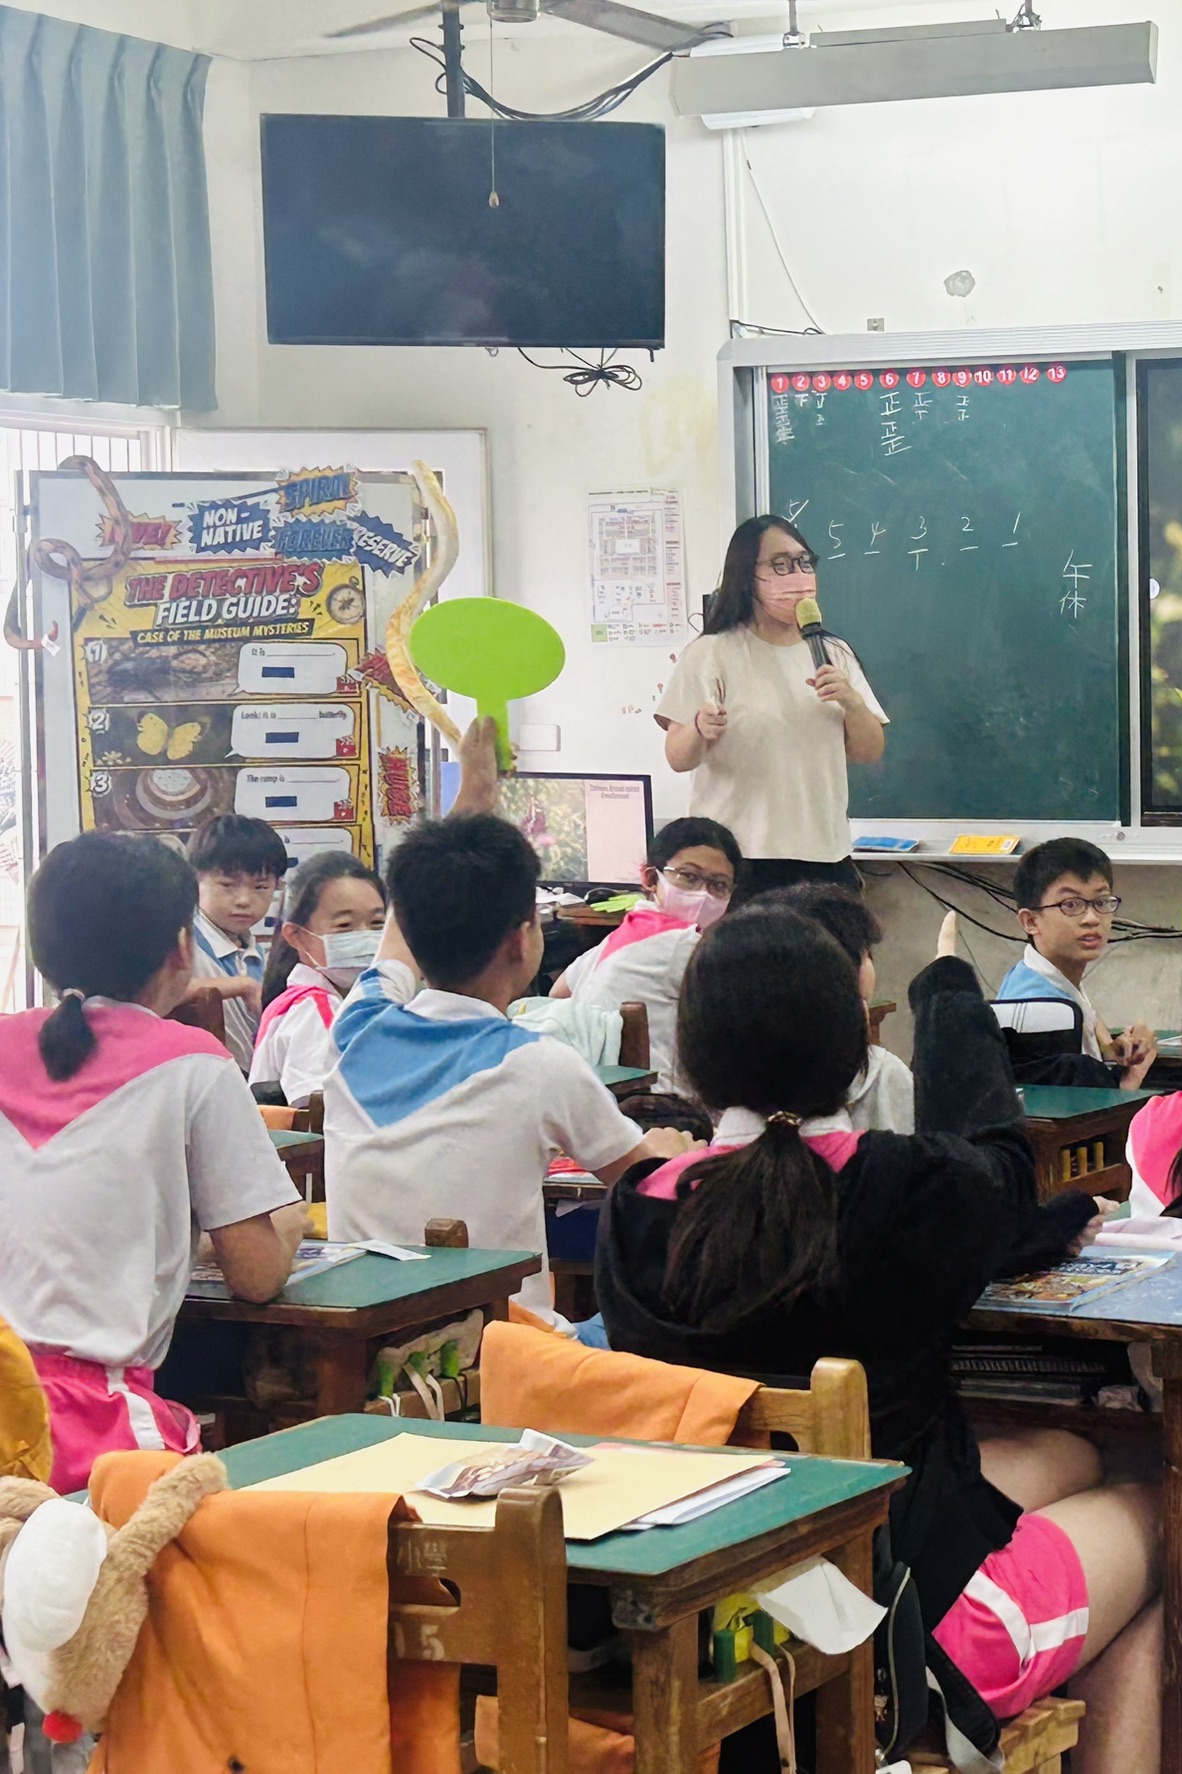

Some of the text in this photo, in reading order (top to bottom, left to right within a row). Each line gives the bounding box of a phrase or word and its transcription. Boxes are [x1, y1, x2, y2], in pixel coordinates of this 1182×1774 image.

[796, 375, 806, 385] 2
[818, 375, 827, 388] 3
[838, 373, 848, 386] 4
[859, 374, 869, 386] 5
[885, 373, 895, 385] 6
[911, 372, 920, 384] 7
[937, 372, 946, 384] 8
[957, 372, 967, 384] 9
[975, 370, 992, 384] 10
[1001, 369, 1014, 381] 11
[1024, 366, 1039, 380] 12
[1050, 366, 1065, 379] 13
[201, 520, 263, 547] NATIVE
[828, 519, 844, 548] 5
[870, 521, 886, 546] 4
[910, 516, 927, 540] 3
[961, 516, 974, 532] 2
[127, 562, 323, 601] THE DETECTIVE'S
[156, 594, 297, 625] FIELD GUIDE:
[137, 622, 309, 643] CASE OF THE MUSEUM MYSTERIES
[90, 642, 102, 662] 1
[92, 713, 105, 731] 2
[95, 775, 108, 793] 3
